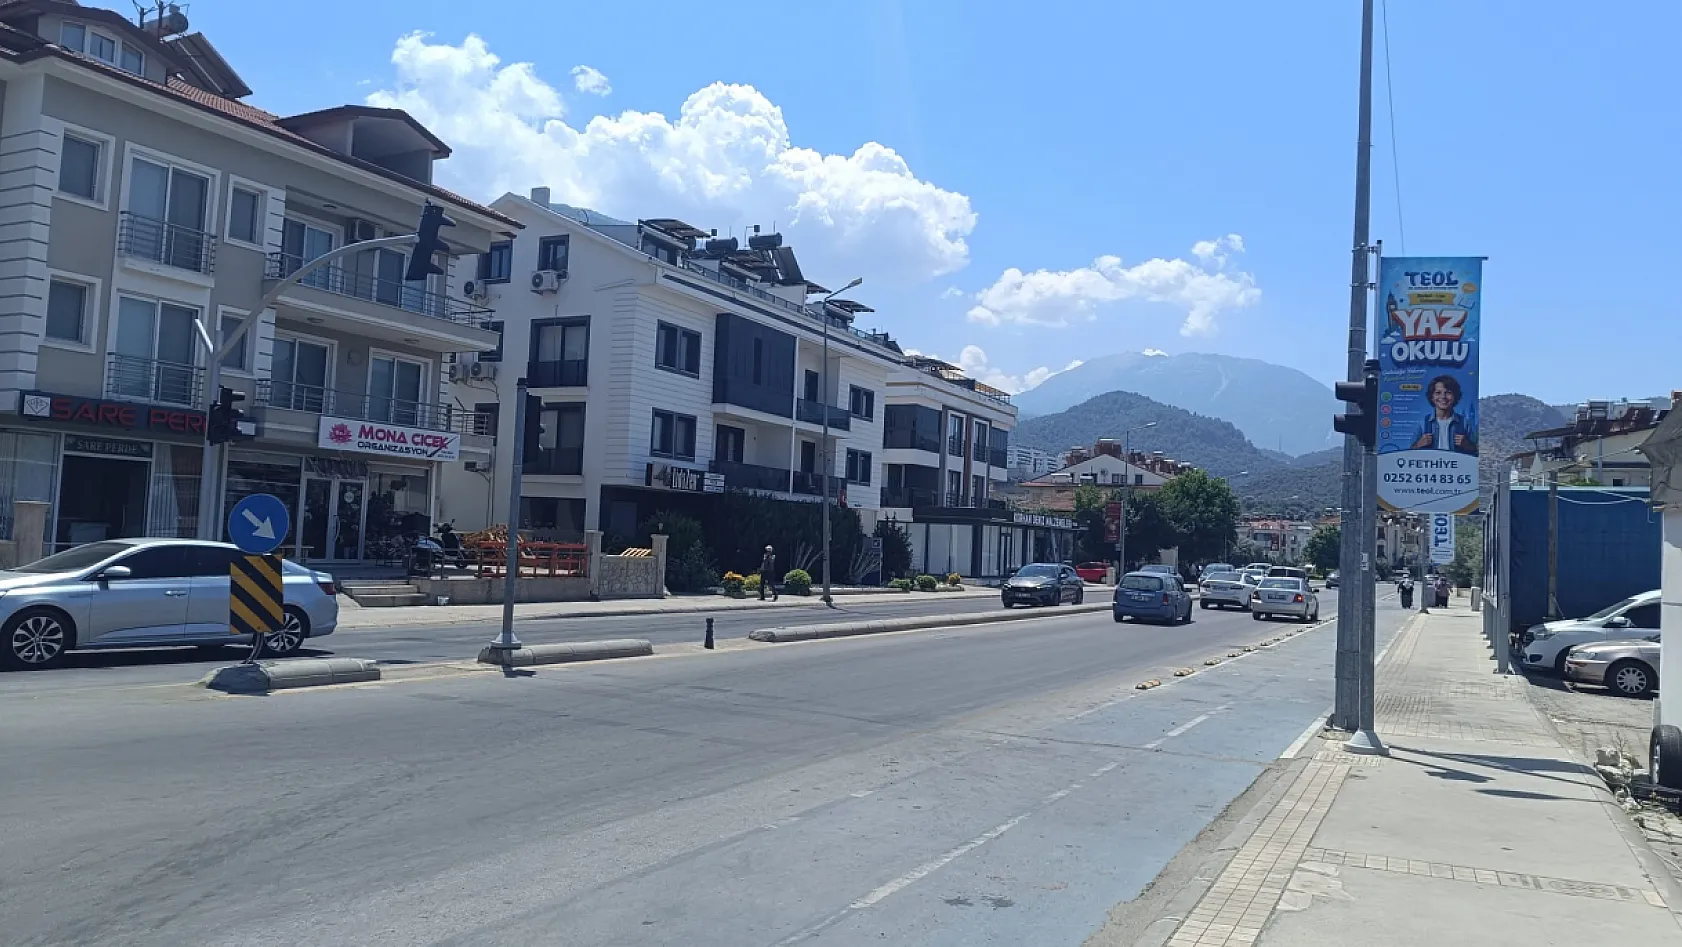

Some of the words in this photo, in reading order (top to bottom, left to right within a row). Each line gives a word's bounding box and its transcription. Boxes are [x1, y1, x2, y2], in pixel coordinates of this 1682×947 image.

[1403, 270, 1459, 287] TEOL
[1392, 308, 1467, 339] YAZ
[1391, 340, 1469, 362] OKULU
[51, 396, 138, 427] SARE
[358, 424, 409, 445] MONA
[357, 441, 428, 456] ORGANIZASYON
[1408, 458, 1458, 469] FETHİYE
[1383, 473, 1412, 483] 0252
[1415, 473, 1437, 484] 614
[1439, 474, 1454, 484] 83
[1456, 474, 1472, 484] 65
[1393, 487, 1462, 495] www.teol.com.tr
